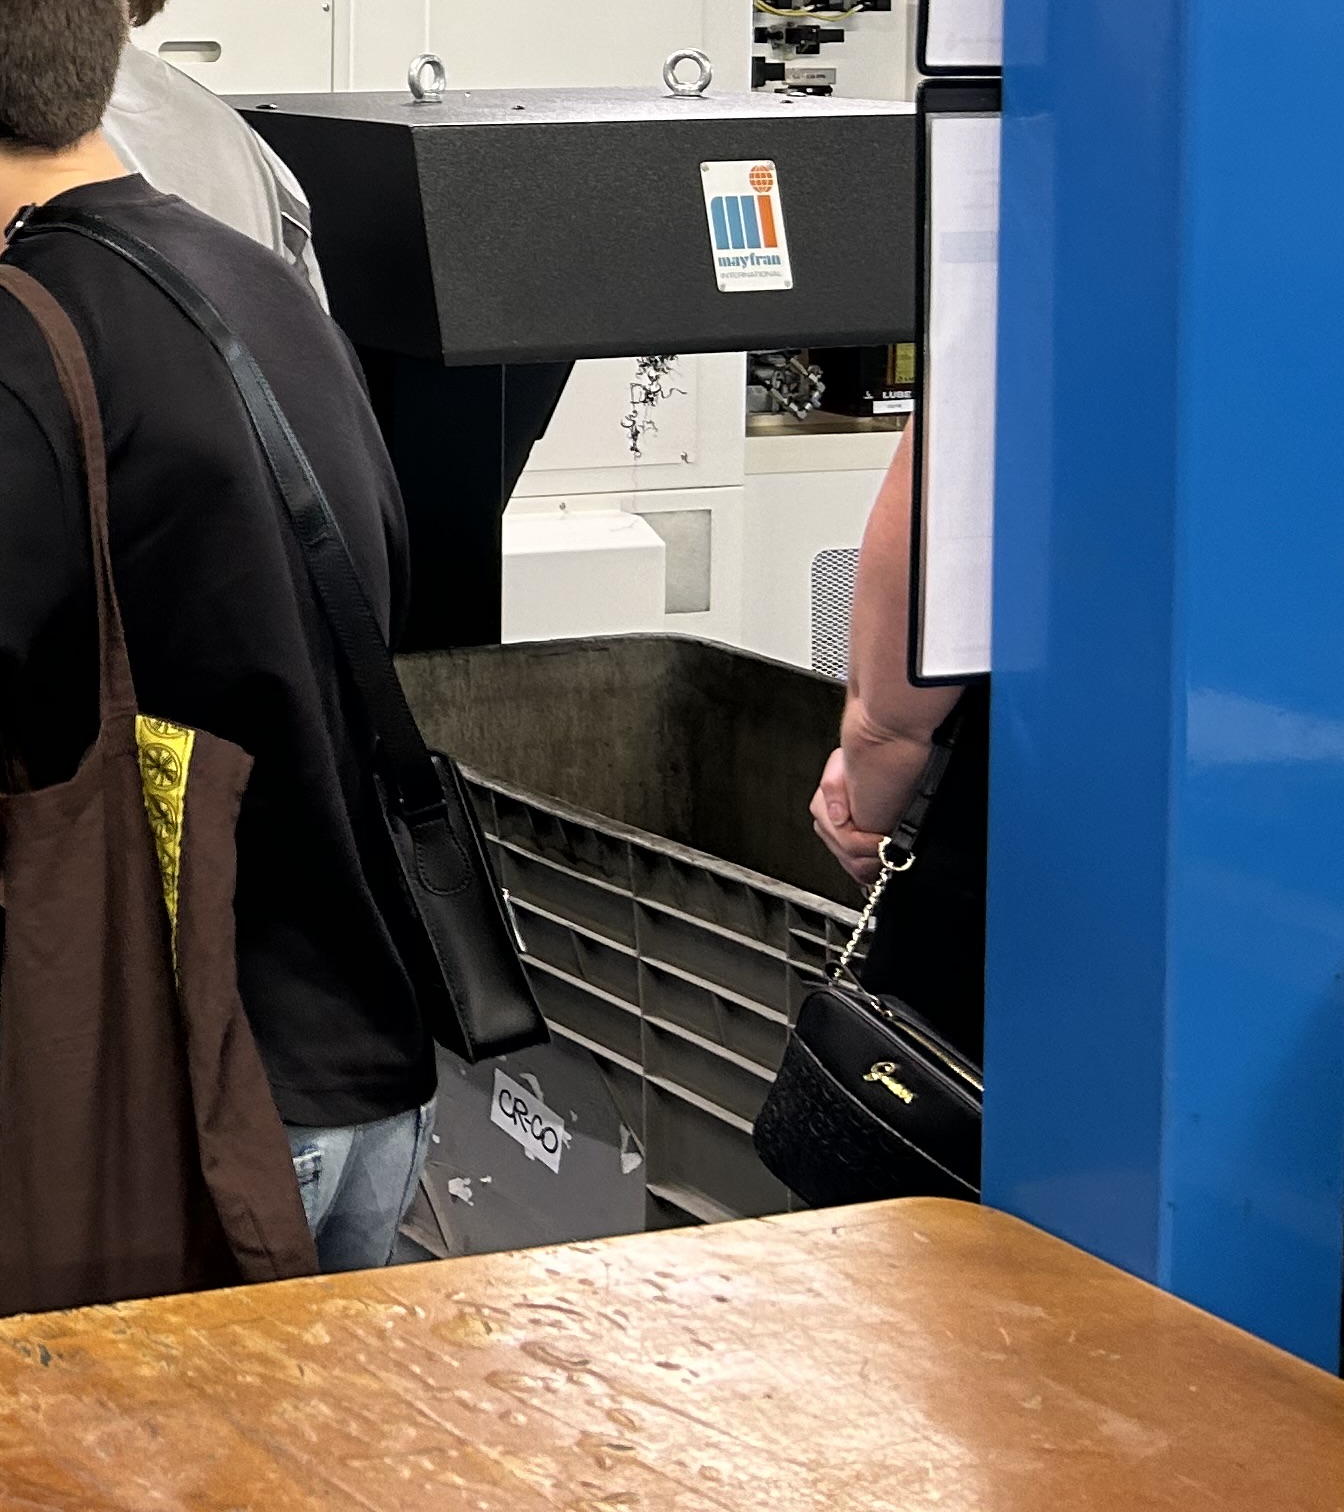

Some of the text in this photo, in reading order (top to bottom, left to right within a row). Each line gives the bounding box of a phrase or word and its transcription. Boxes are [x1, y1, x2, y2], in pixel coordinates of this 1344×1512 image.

[718, 252, 782, 269] mayfran
[720, 270, 783, 279] INTERNATIONAL
[882, 390, 912, 399] LUBE
